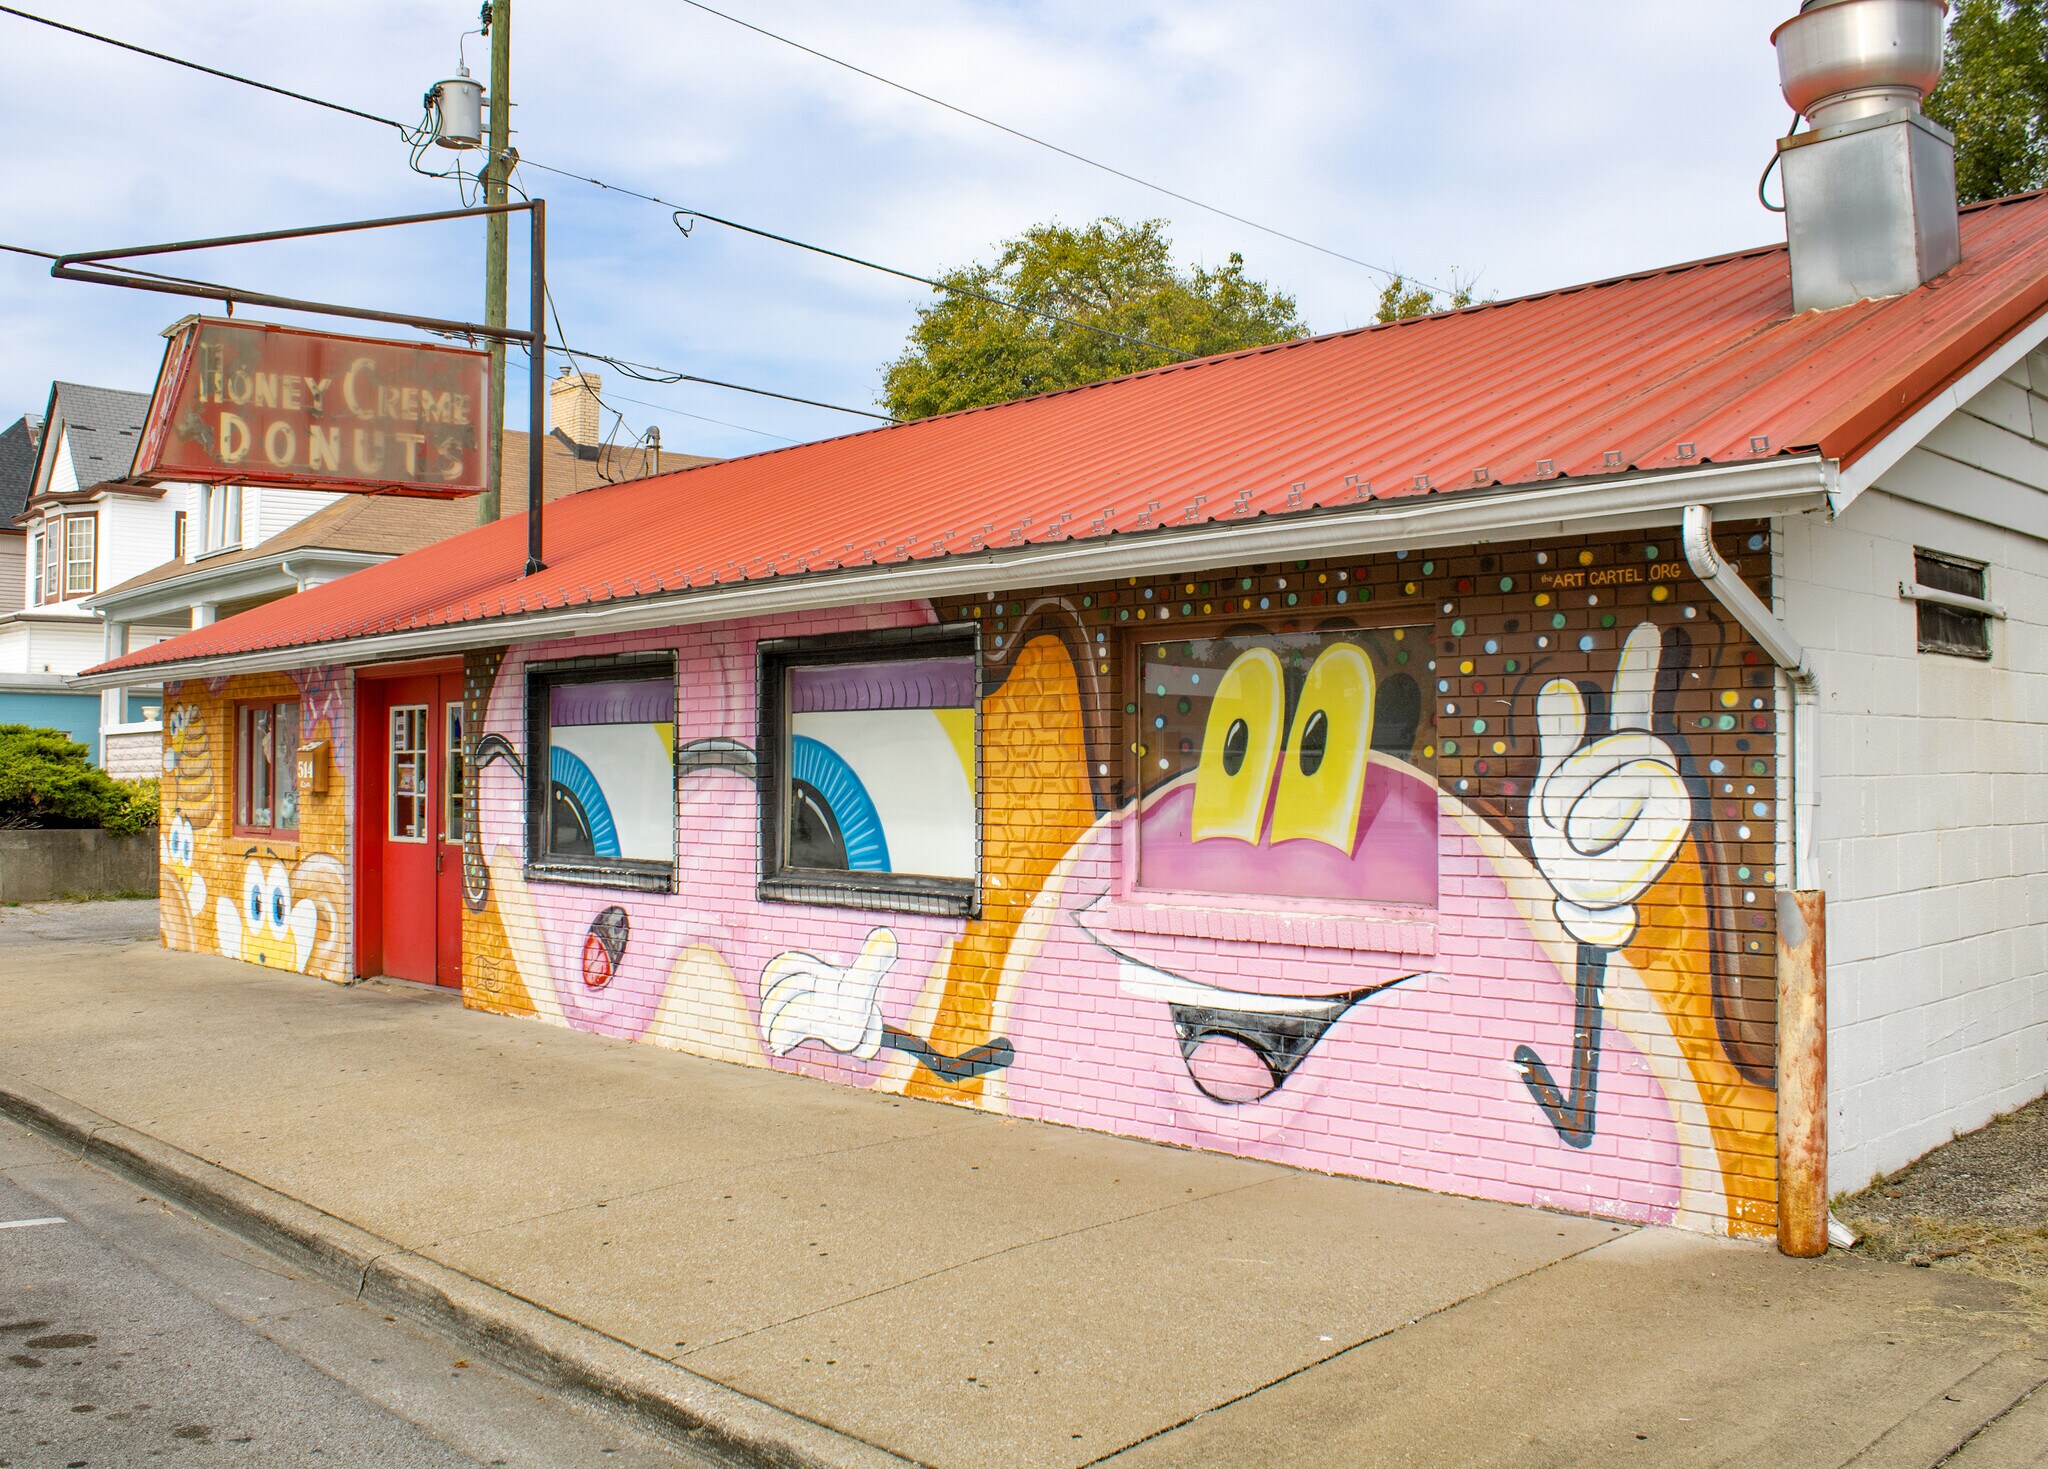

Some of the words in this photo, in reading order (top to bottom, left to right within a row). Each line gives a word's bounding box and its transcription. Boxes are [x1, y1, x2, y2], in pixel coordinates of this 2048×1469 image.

[199, 343, 332, 411] HONEY
[344, 357, 471, 426] CREME
[219, 412, 464, 481] DONUTS
[1553, 573, 1585, 588] ART
[1589, 569, 1643, 585] CARTEL
[297, 761, 313, 779] 514
